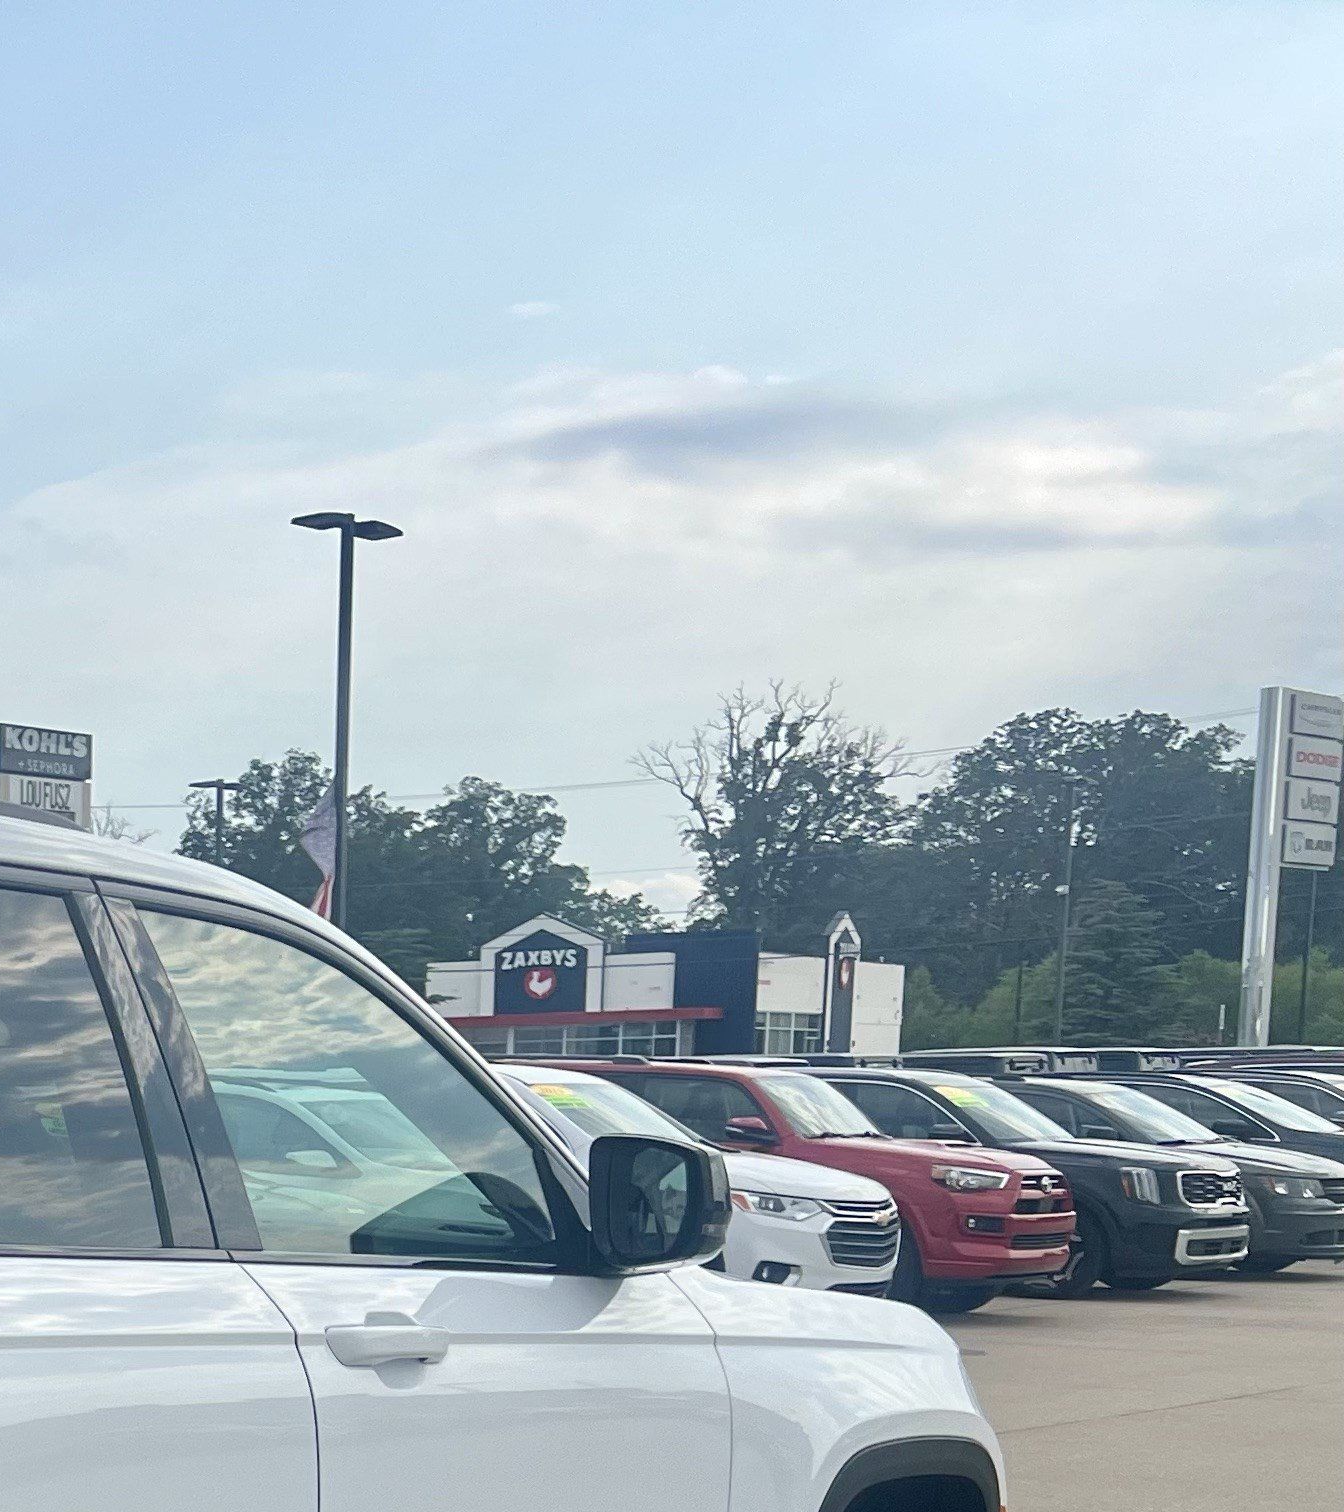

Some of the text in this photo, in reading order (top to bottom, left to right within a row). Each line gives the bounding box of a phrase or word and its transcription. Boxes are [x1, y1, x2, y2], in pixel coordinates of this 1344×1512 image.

[5, 726, 88, 758] KOHL'S
[27, 758, 75, 775] SEPHORA
[20, 779, 71, 811] LOU FUSZ
[500, 948, 578, 972] ZAXBYS
